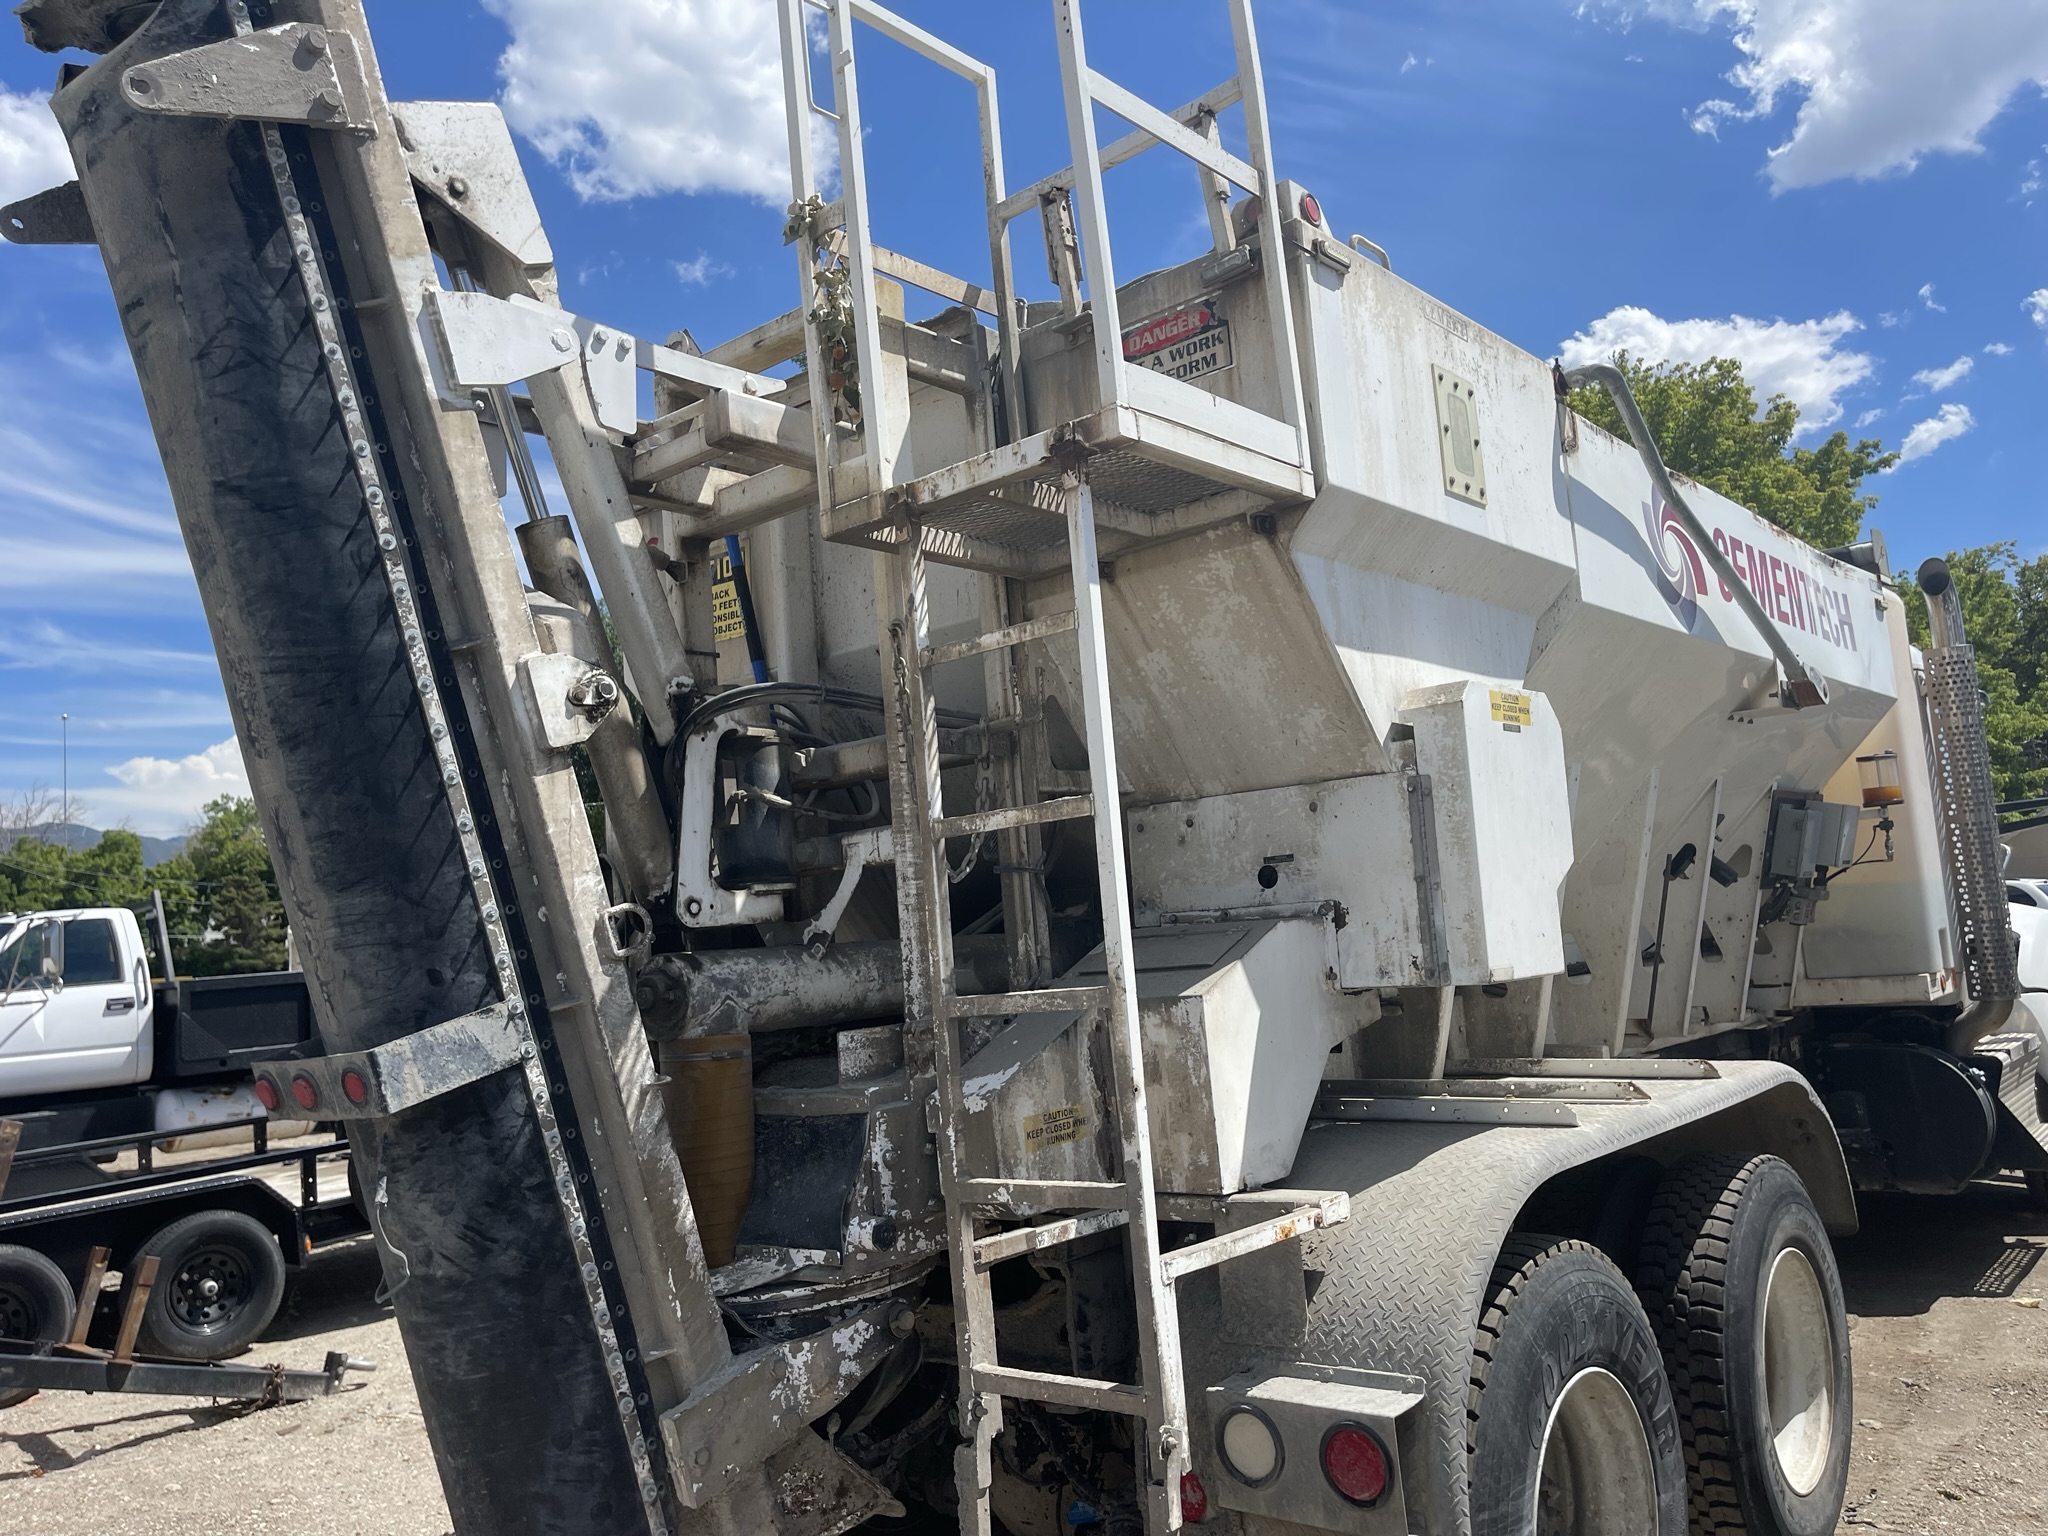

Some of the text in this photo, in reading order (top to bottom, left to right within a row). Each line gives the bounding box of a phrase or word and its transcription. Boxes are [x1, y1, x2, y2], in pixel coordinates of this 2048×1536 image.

[1128, 310, 1201, 353] DANGER
[1169, 331, 1224, 362] WORK
[1160, 352, 1218, 380] FORM
[719, 598, 738, 612] FEET
[1501, 693, 1520, 702] CAUTION
[1491, 702, 1530, 715] KEEP CLOSED WHEN
[1503, 713, 1521, 722] RUNNING
[1043, 1107, 1074, 1122] CAUTION
[1026, 1127, 1044, 1140] KEEP
[1045, 1121, 1071, 1135] CLOSED
[1046, 1130, 1076, 1146] RUNNING
[1527, 1302, 1677, 1461] GOODYEAR
